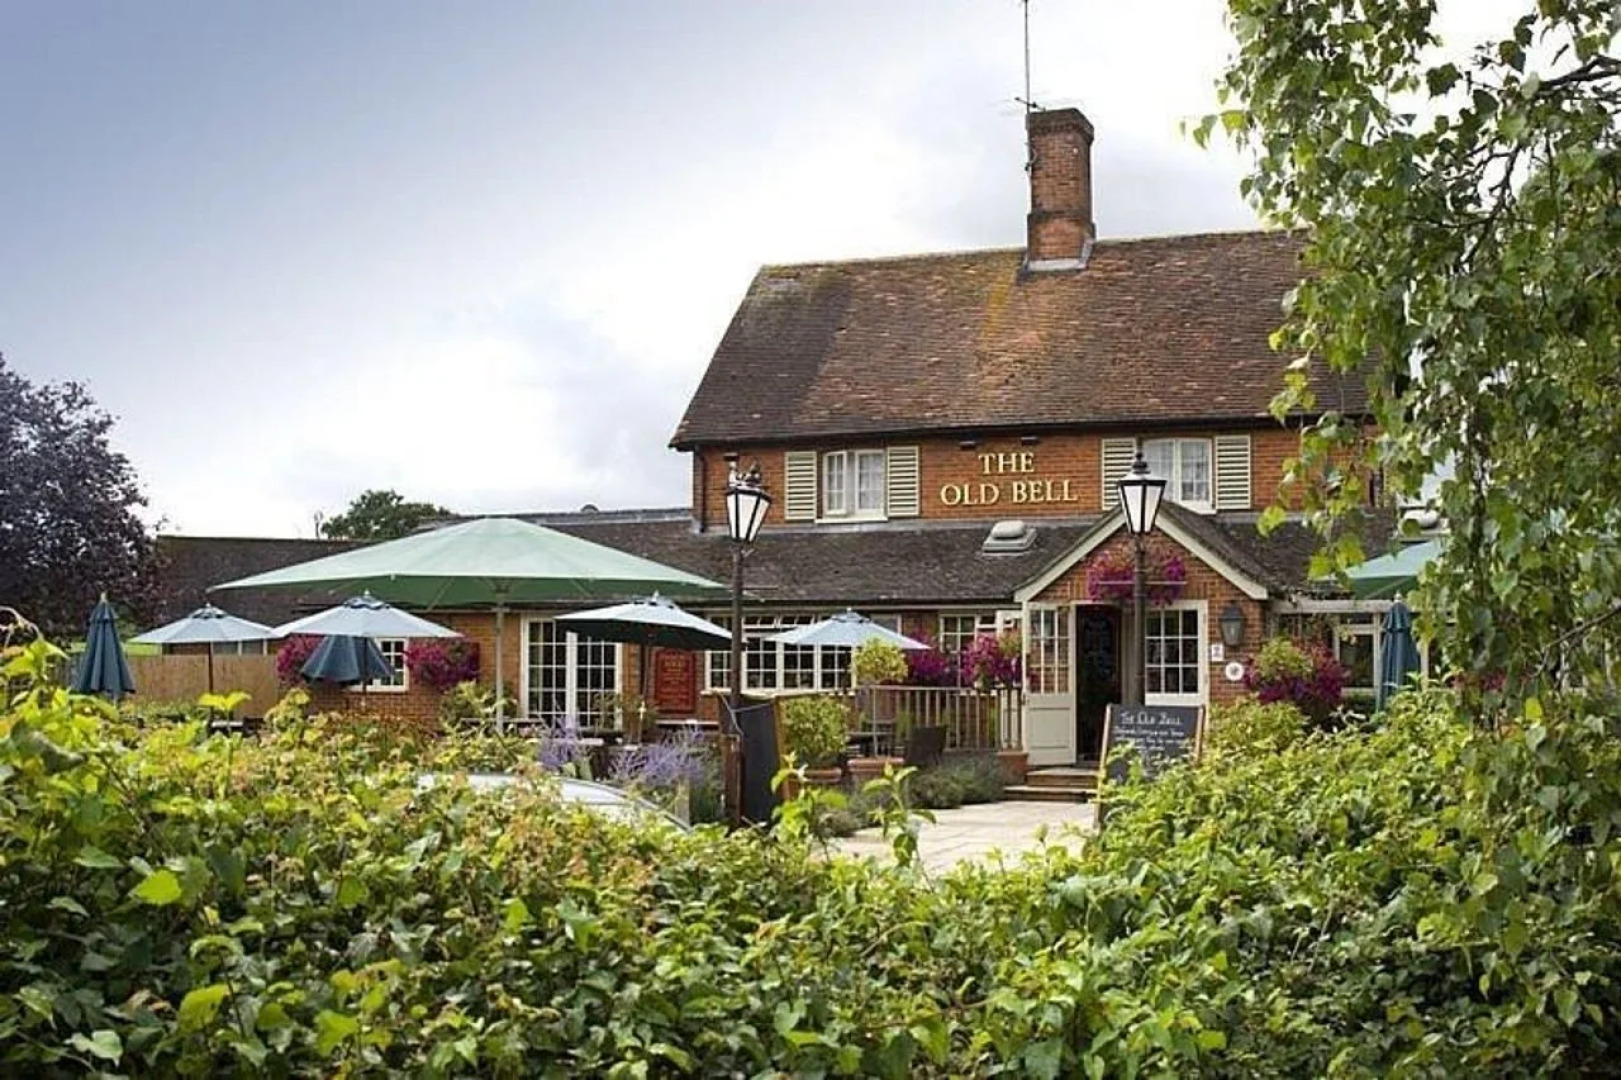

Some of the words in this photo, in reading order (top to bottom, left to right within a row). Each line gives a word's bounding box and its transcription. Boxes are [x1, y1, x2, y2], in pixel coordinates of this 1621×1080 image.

[978, 452, 1035, 474] THE
[940, 483, 999, 505] OLD
[1012, 479, 1079, 503] BELL
